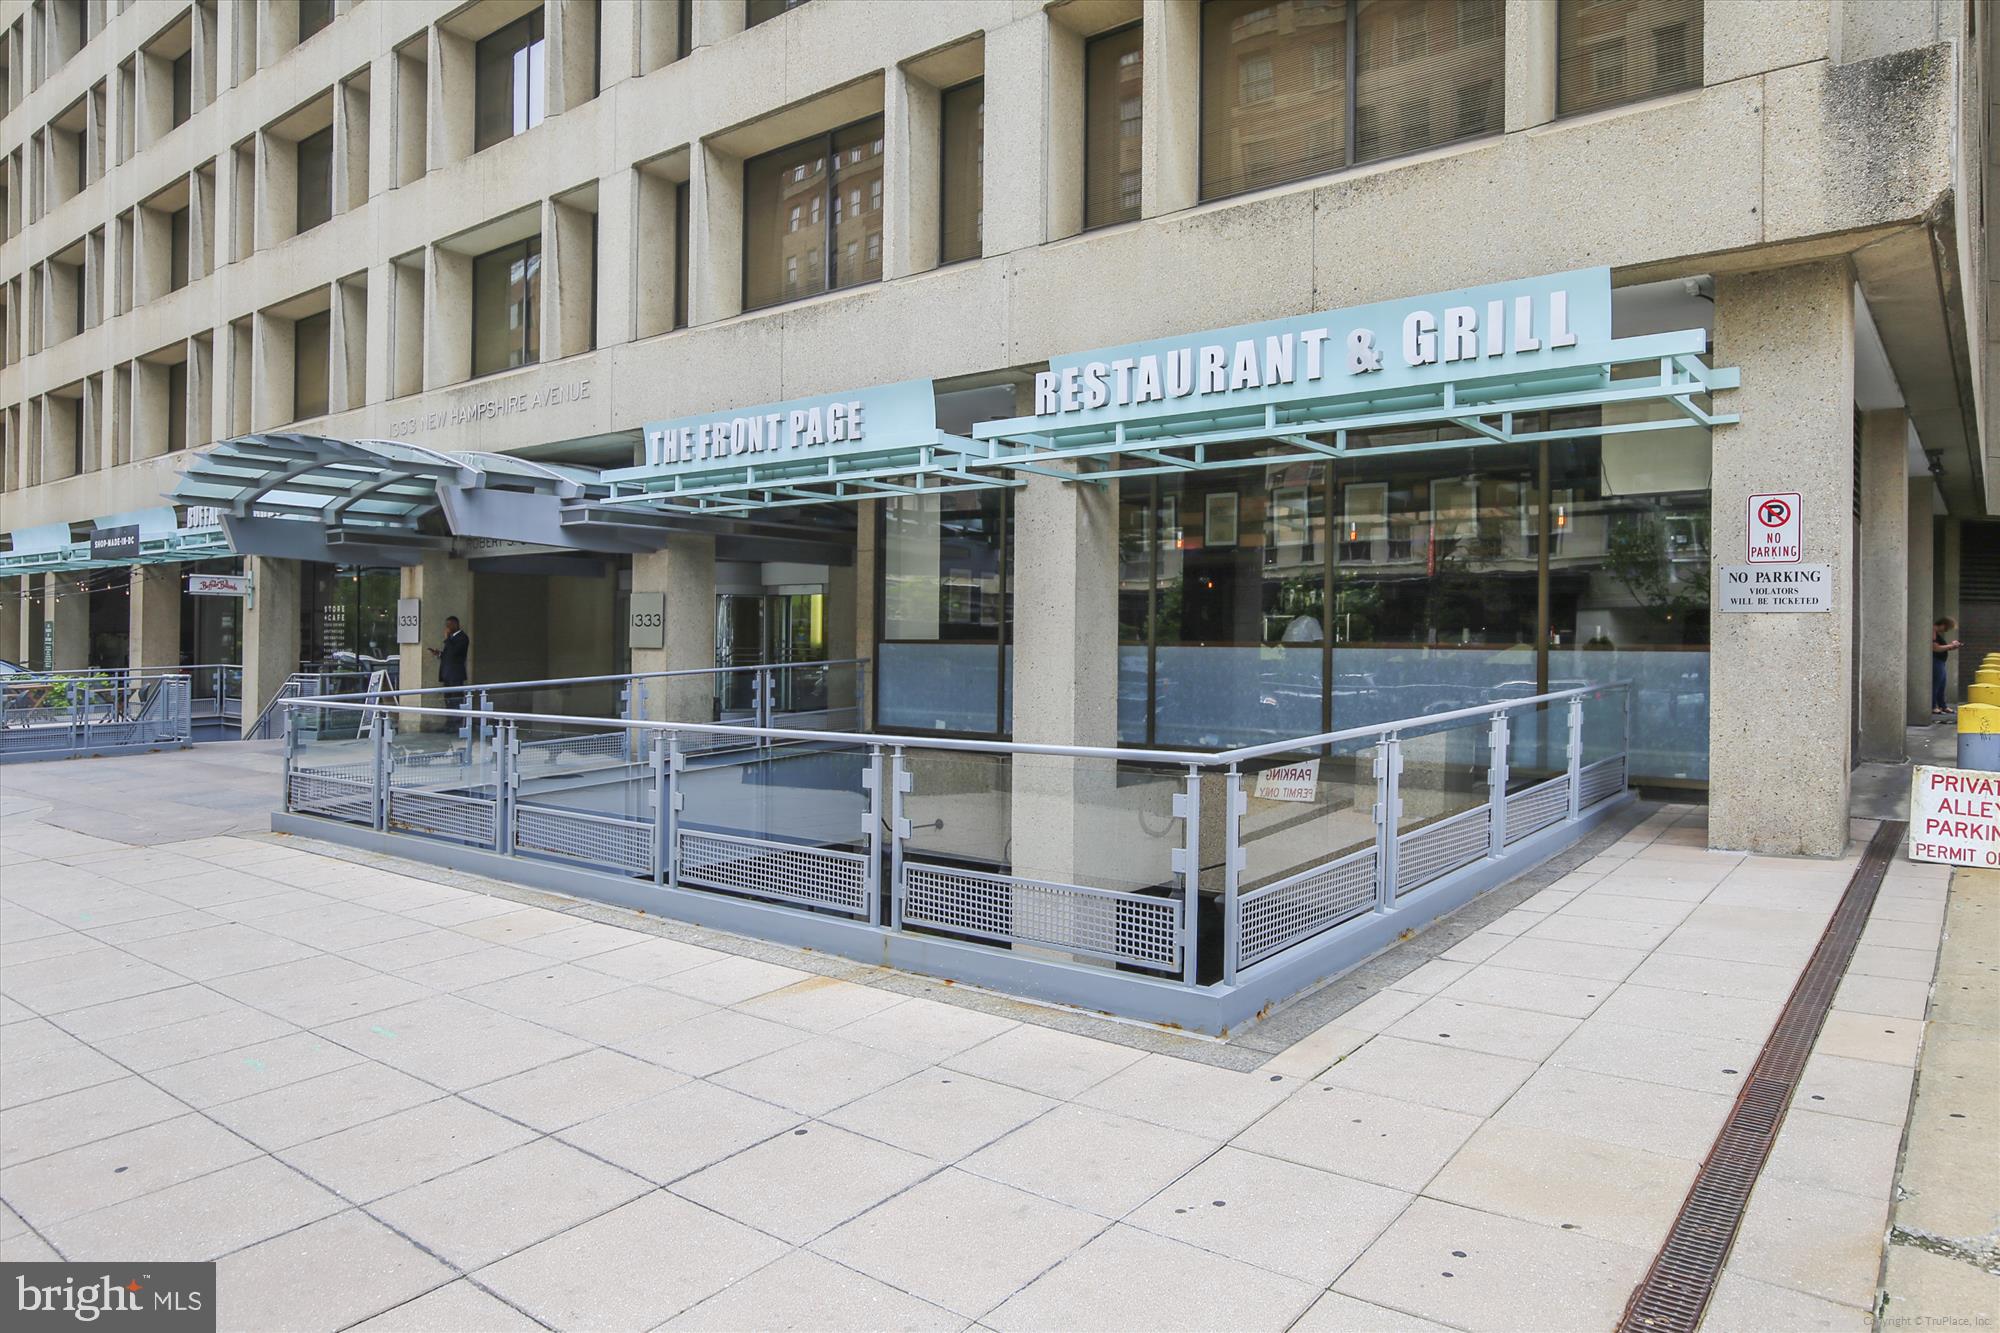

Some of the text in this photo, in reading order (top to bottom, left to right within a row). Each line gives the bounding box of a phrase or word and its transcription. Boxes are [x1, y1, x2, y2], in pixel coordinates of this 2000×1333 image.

[1035, 290, 1579, 417] RESTAURANT & GRILL
[388, 380, 591, 438] 1333 NEW HAMPSHIRE AVENUE
[650, 400, 865, 465] THE FRONT PAGE
[1767, 532, 1781, 544] NO
[1751, 546, 1797, 557] PARKING
[1728, 571, 1821, 583] NO PARKING
[1749, 587, 1799, 595] VIOLATORS
[1773, 597, 1819, 605] TICKETED
[324, 605, 345, 613] STORE
[399, 615, 418, 627] 1333
[632, 614, 662, 627] 1333
[1916, 843, 1976, 862] PERMIT
